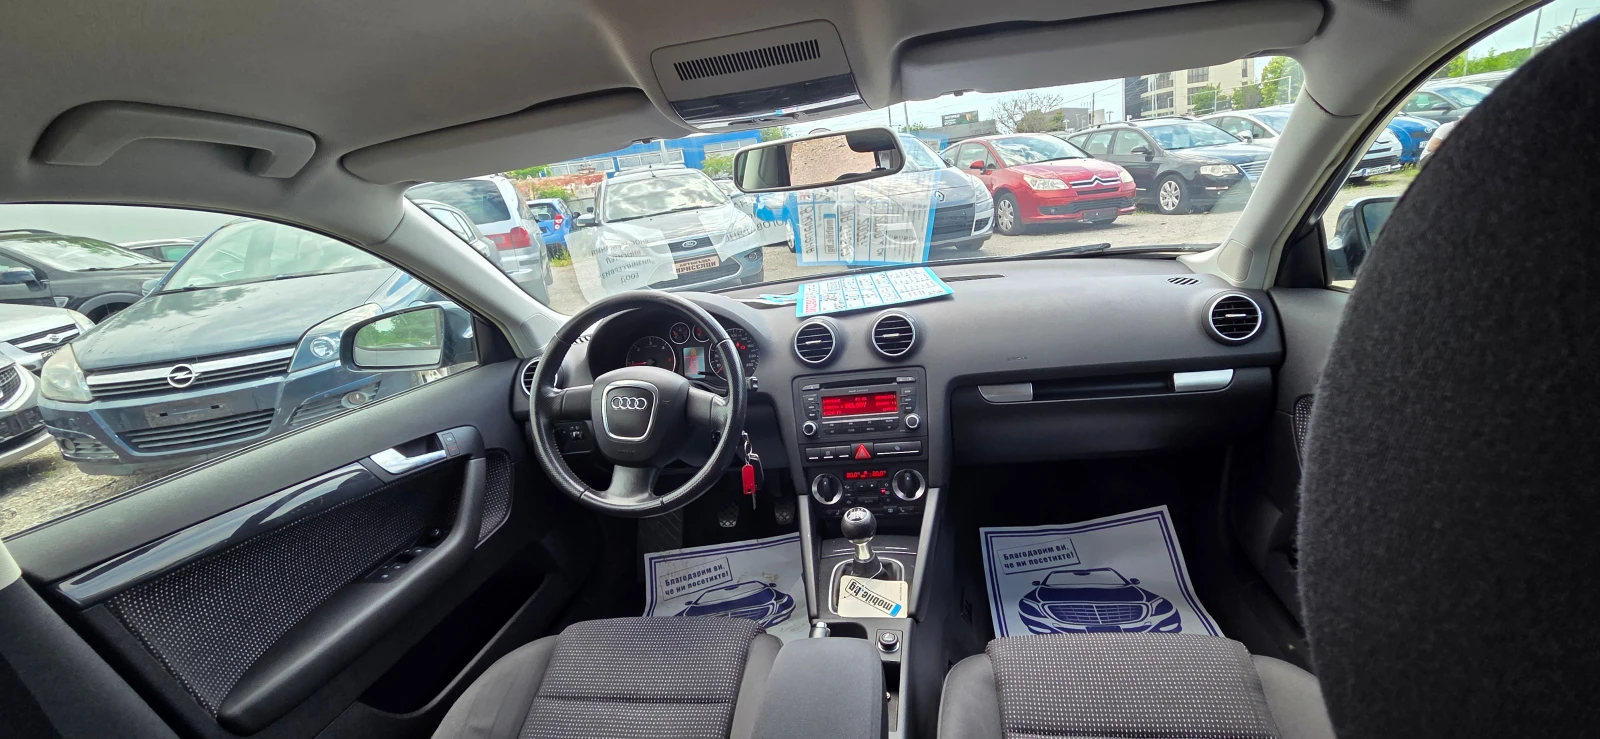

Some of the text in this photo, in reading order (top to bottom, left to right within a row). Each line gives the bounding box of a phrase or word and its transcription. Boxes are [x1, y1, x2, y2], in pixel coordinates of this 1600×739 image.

[1003, 546, 1055, 561] Благодарим
[1016, 560, 1027, 568] ни
[1028, 551, 1075, 566] посетихте!
[665, 567, 712, 587] Благодарим
[665, 570, 729, 596] че ни посетихте!
[848, 581, 894, 611] mobile.bg
